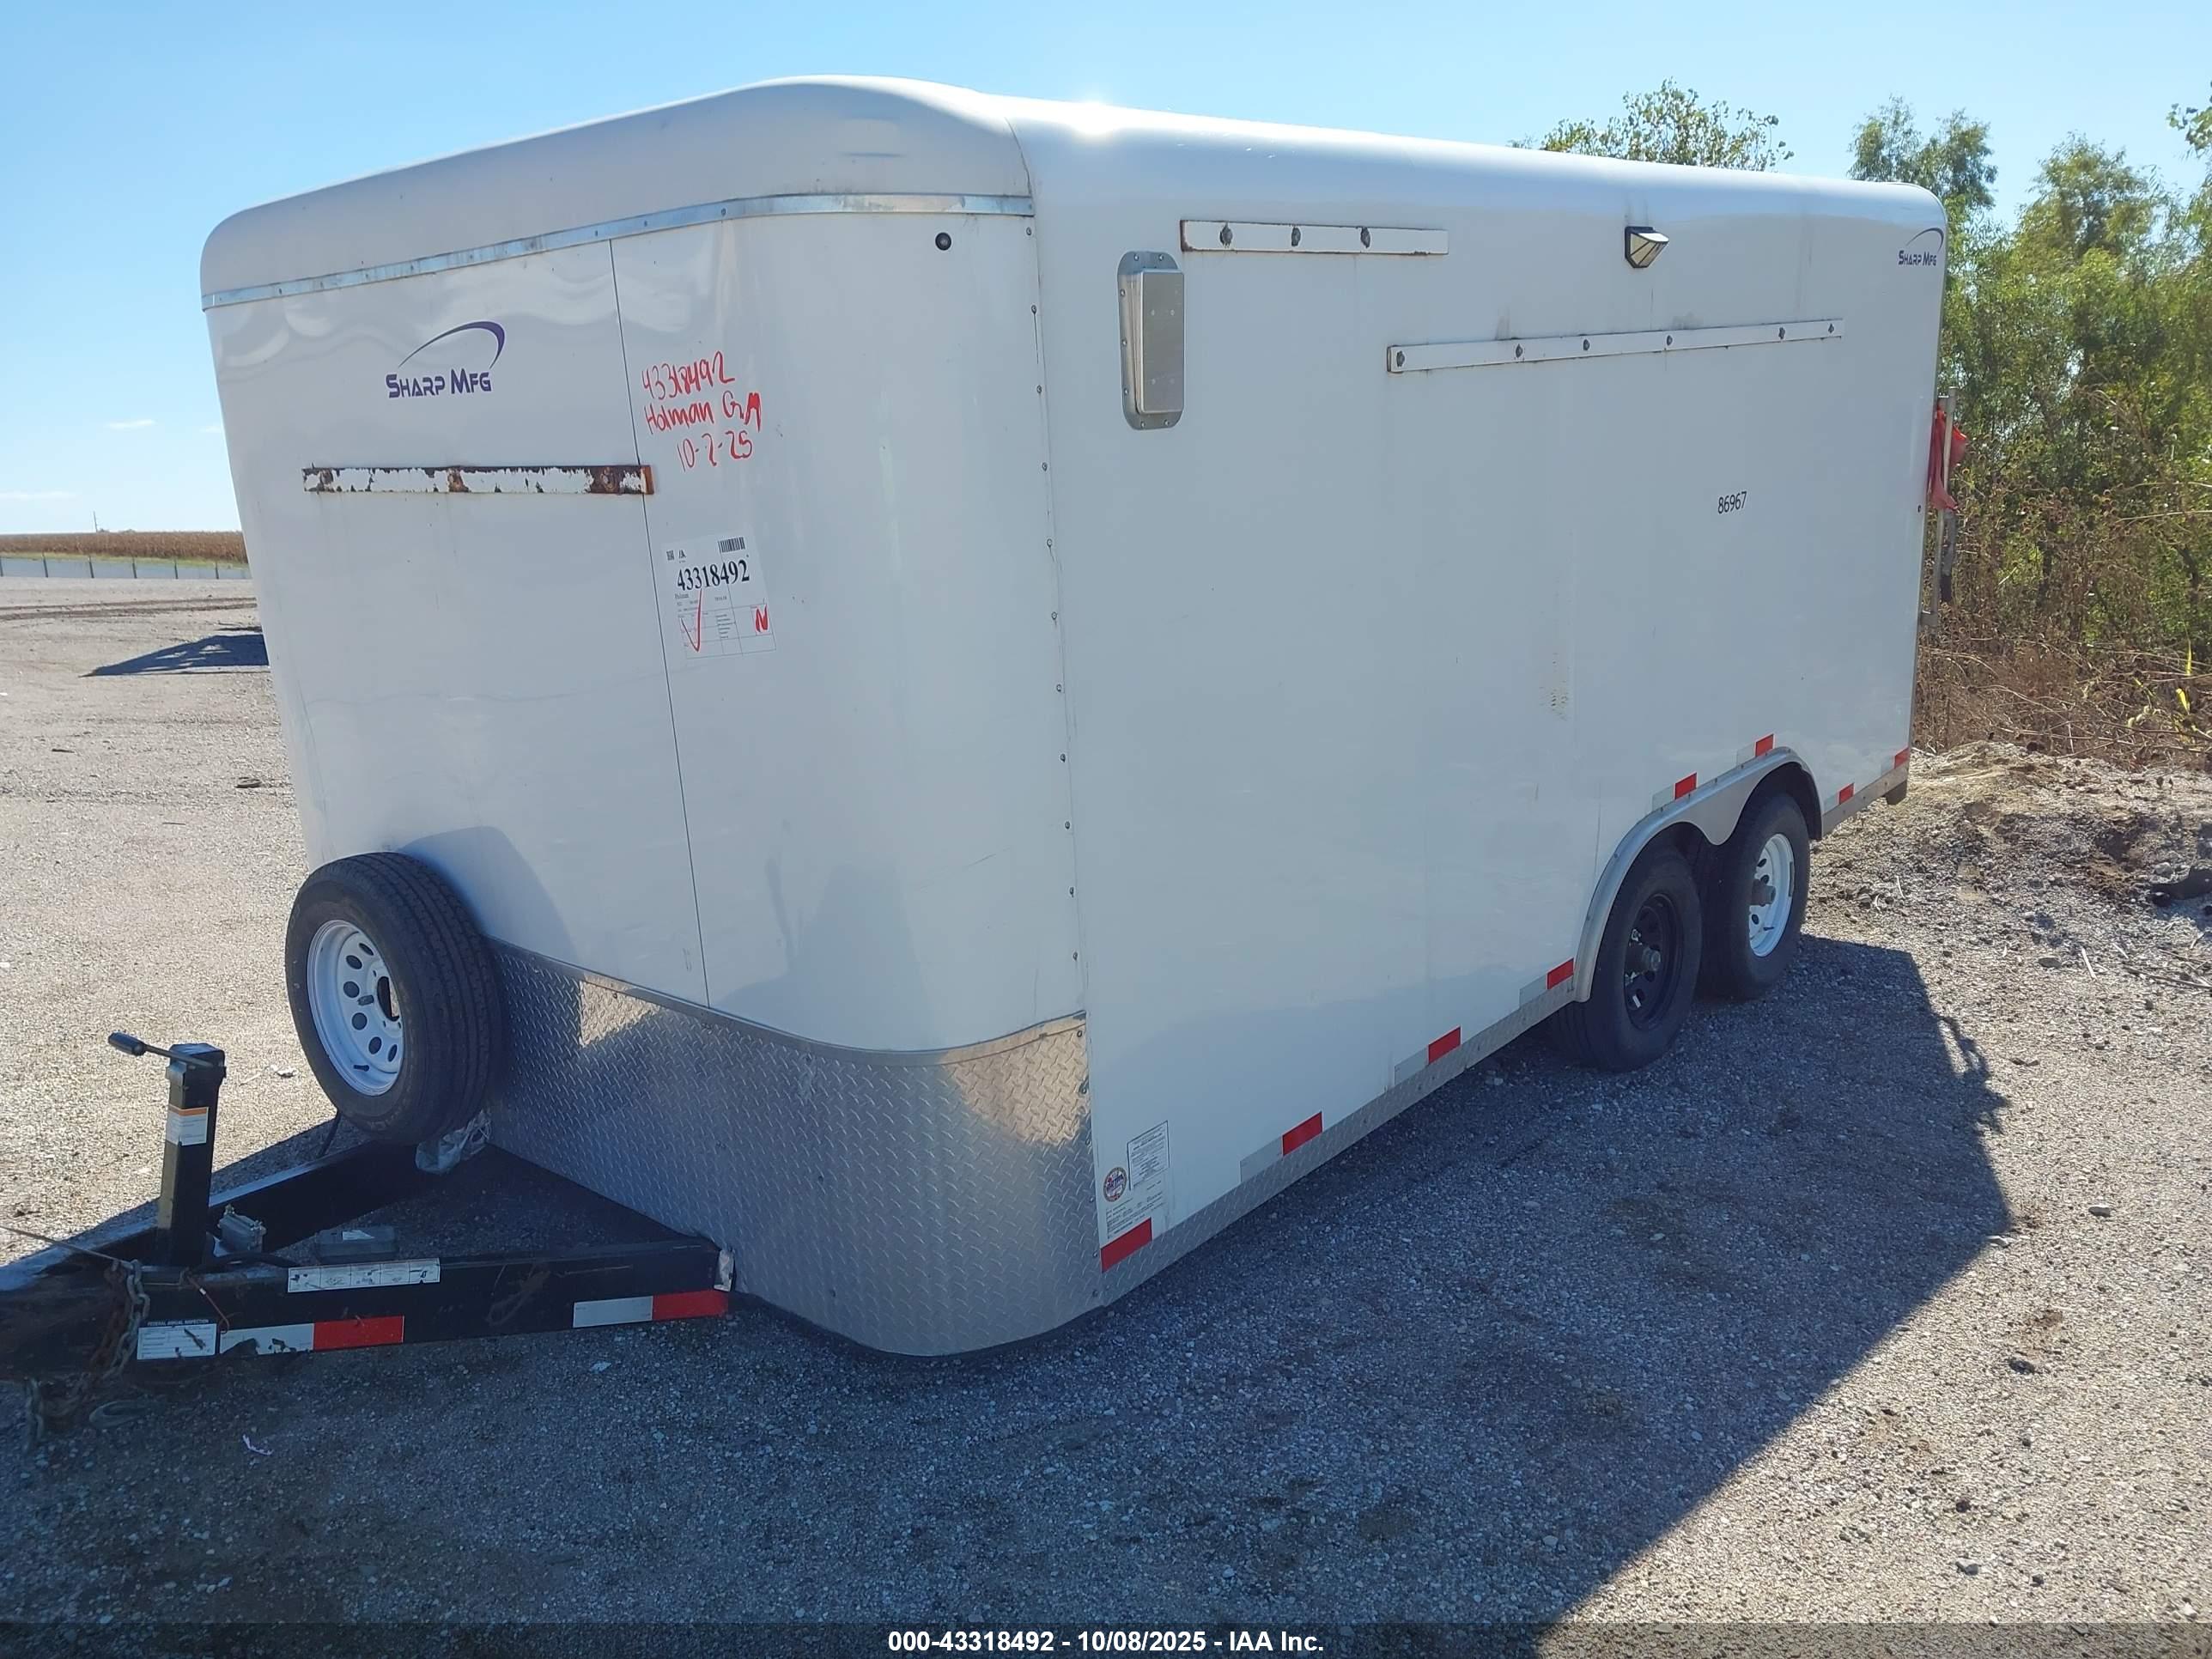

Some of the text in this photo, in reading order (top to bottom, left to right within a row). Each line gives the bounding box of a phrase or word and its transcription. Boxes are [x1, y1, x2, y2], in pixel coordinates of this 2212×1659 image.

[386, 368, 491, 398] SHARP MFG
[1718, 491, 1747, 514] 86967
[678, 559, 750, 591] 43318492
